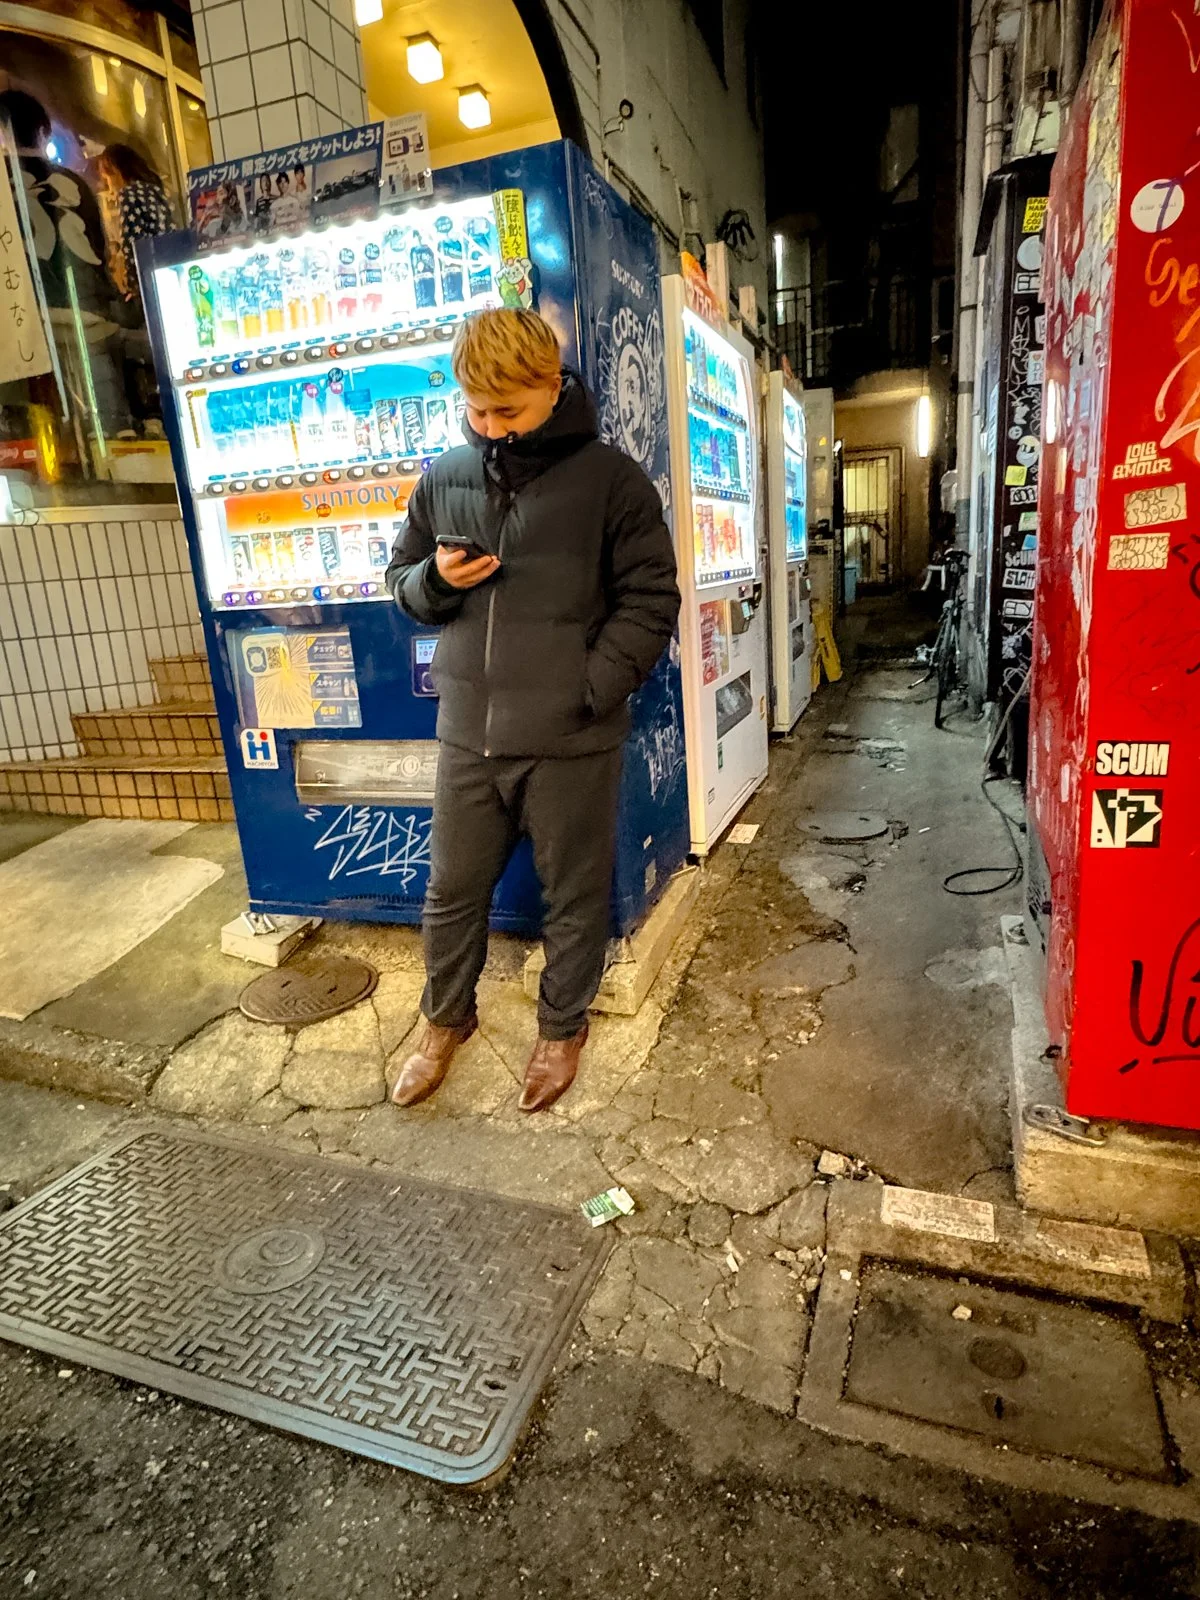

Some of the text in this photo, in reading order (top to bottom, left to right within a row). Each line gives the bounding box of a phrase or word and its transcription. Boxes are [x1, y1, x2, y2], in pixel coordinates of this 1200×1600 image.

[188, 164, 240, 191] レッドブル
[302, 484, 400, 511] SUNTORY
[1096, 742, 1170, 776] SCUM
